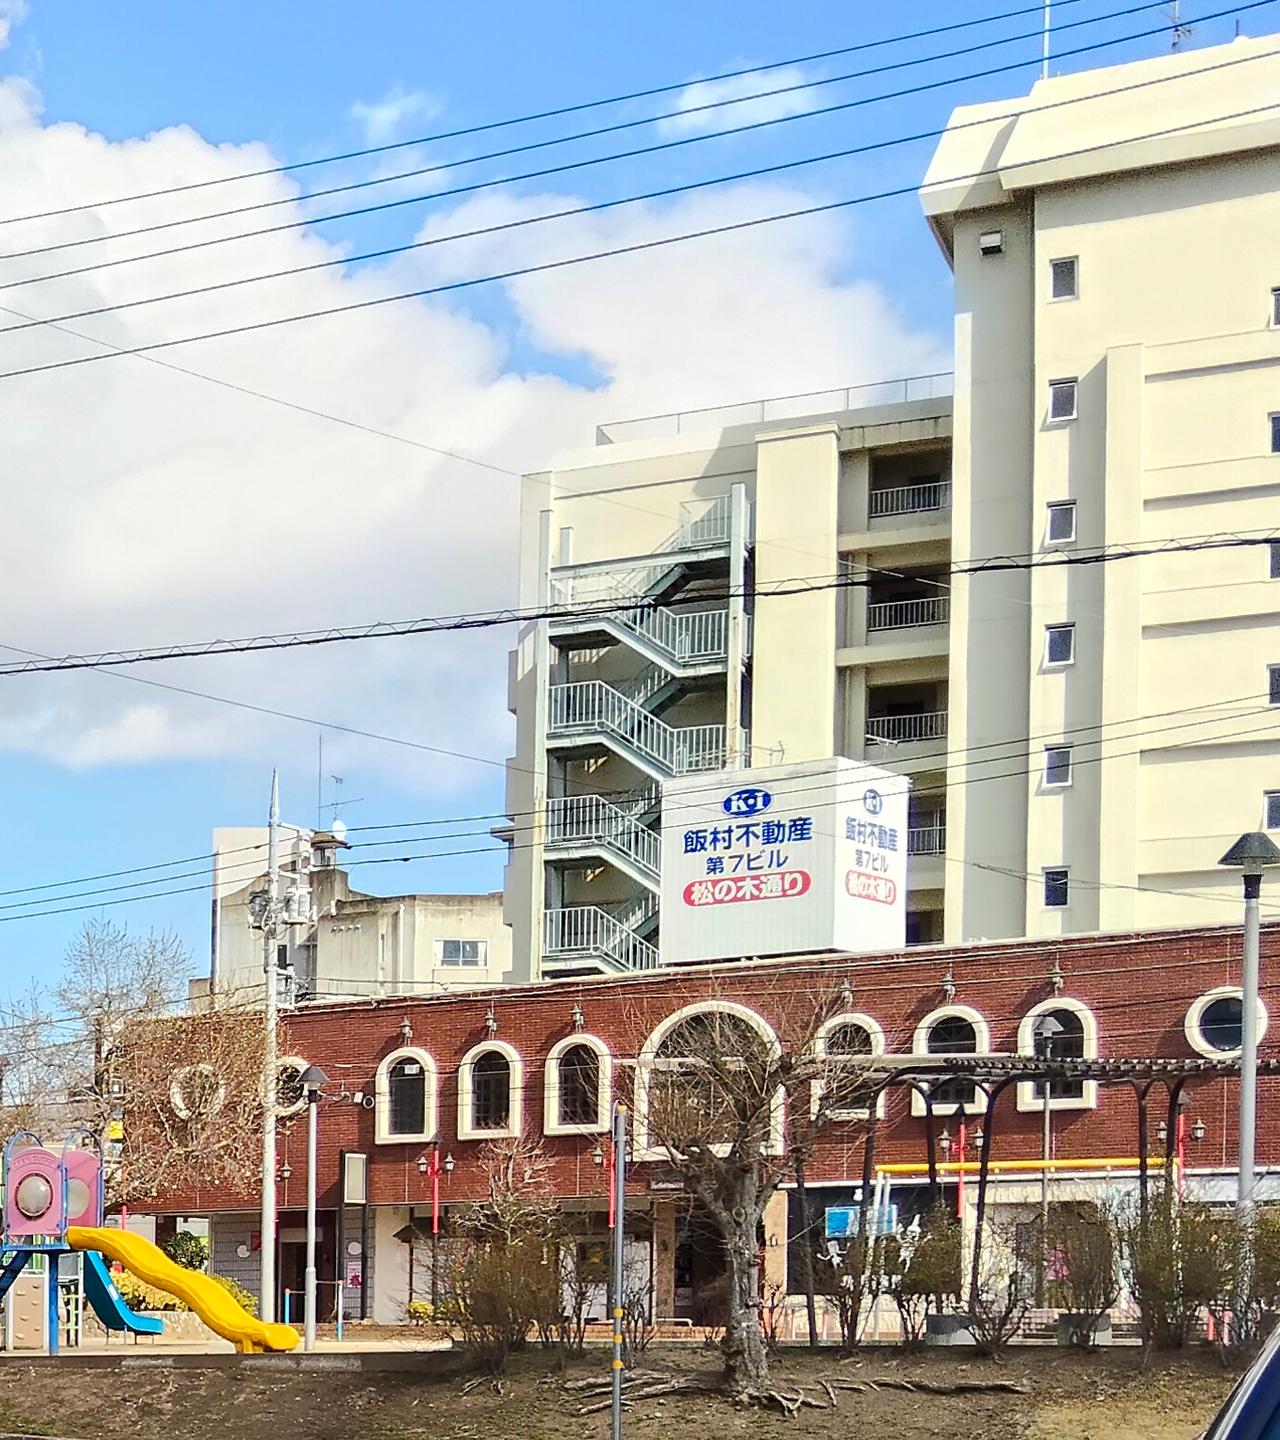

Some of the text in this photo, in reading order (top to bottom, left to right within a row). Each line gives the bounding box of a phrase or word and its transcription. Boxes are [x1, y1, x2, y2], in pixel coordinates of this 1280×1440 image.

[683, 816, 813, 854] 飯村不動産
[845, 816, 898, 852] 飯村不動産
[690, 872, 803, 905] 松の木通り
